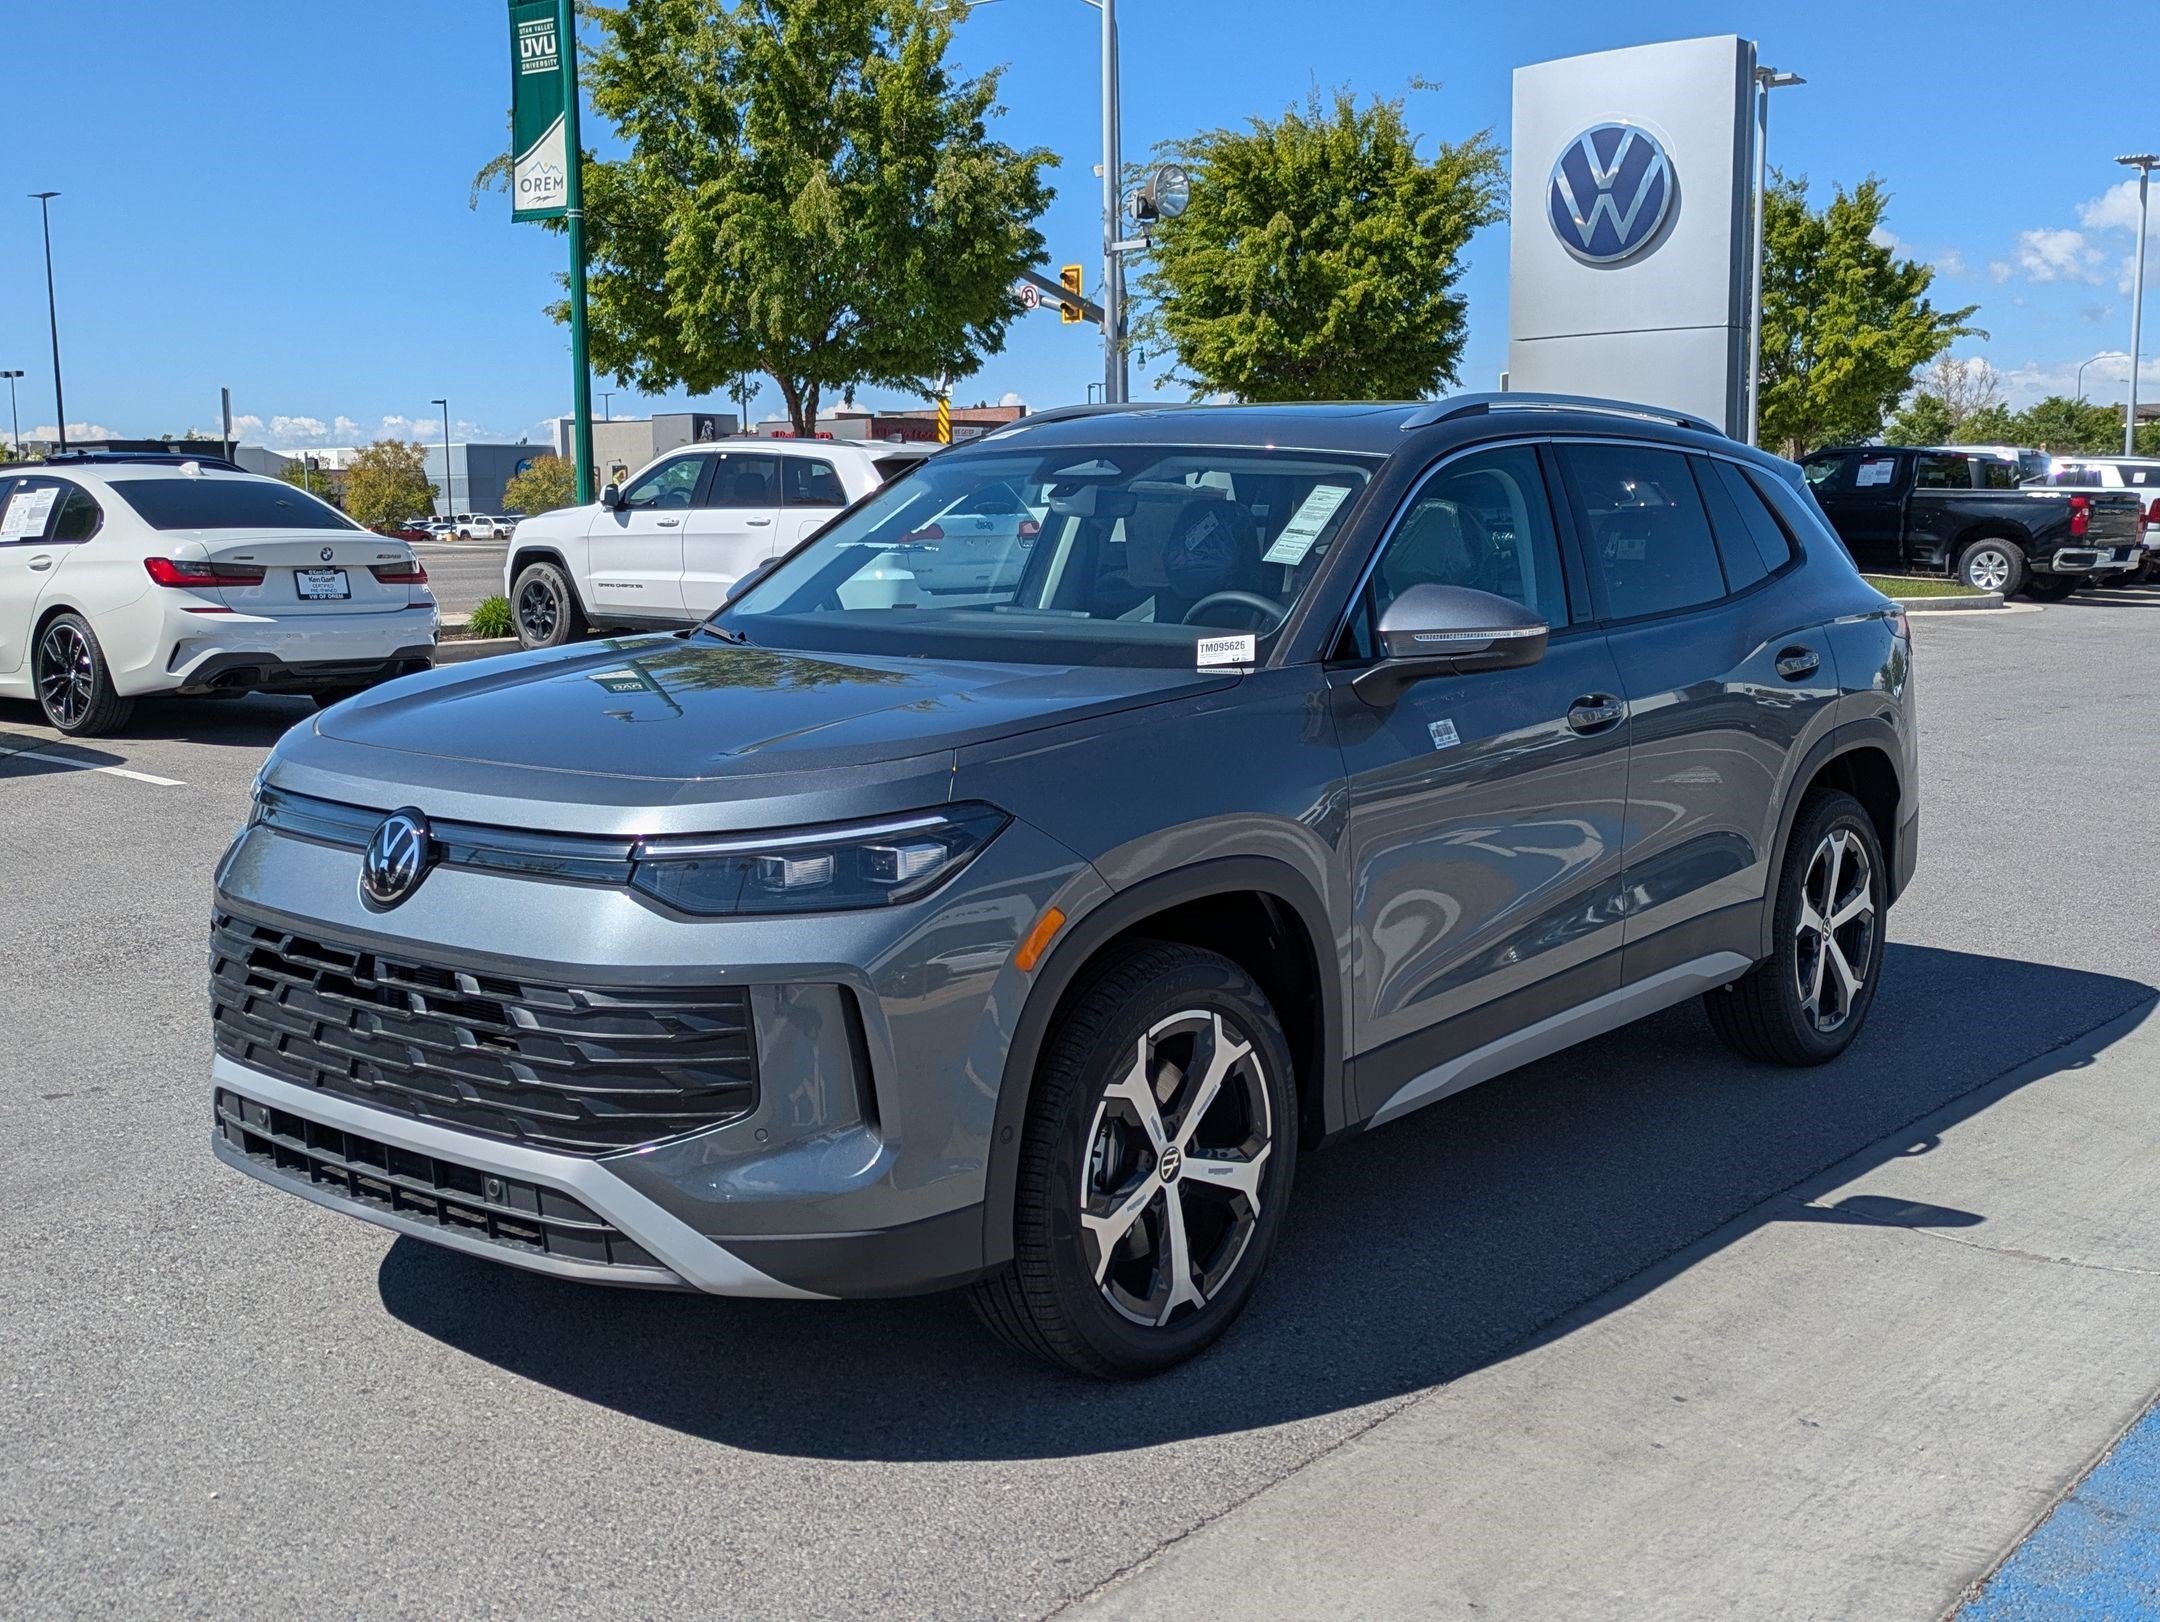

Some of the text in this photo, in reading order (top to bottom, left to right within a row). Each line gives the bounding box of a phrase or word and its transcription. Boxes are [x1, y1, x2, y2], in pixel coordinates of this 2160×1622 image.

[534, 23, 554, 33] VALLEY
[520, 34, 556, 58] UVU
[522, 58, 557, 70] UNIVERSITY
[520, 175, 564, 193] OREM
[1550, 124, 1667, 253] VW
[1200, 640, 1246, 654] TM095626
[366, 816, 419, 897] VW
